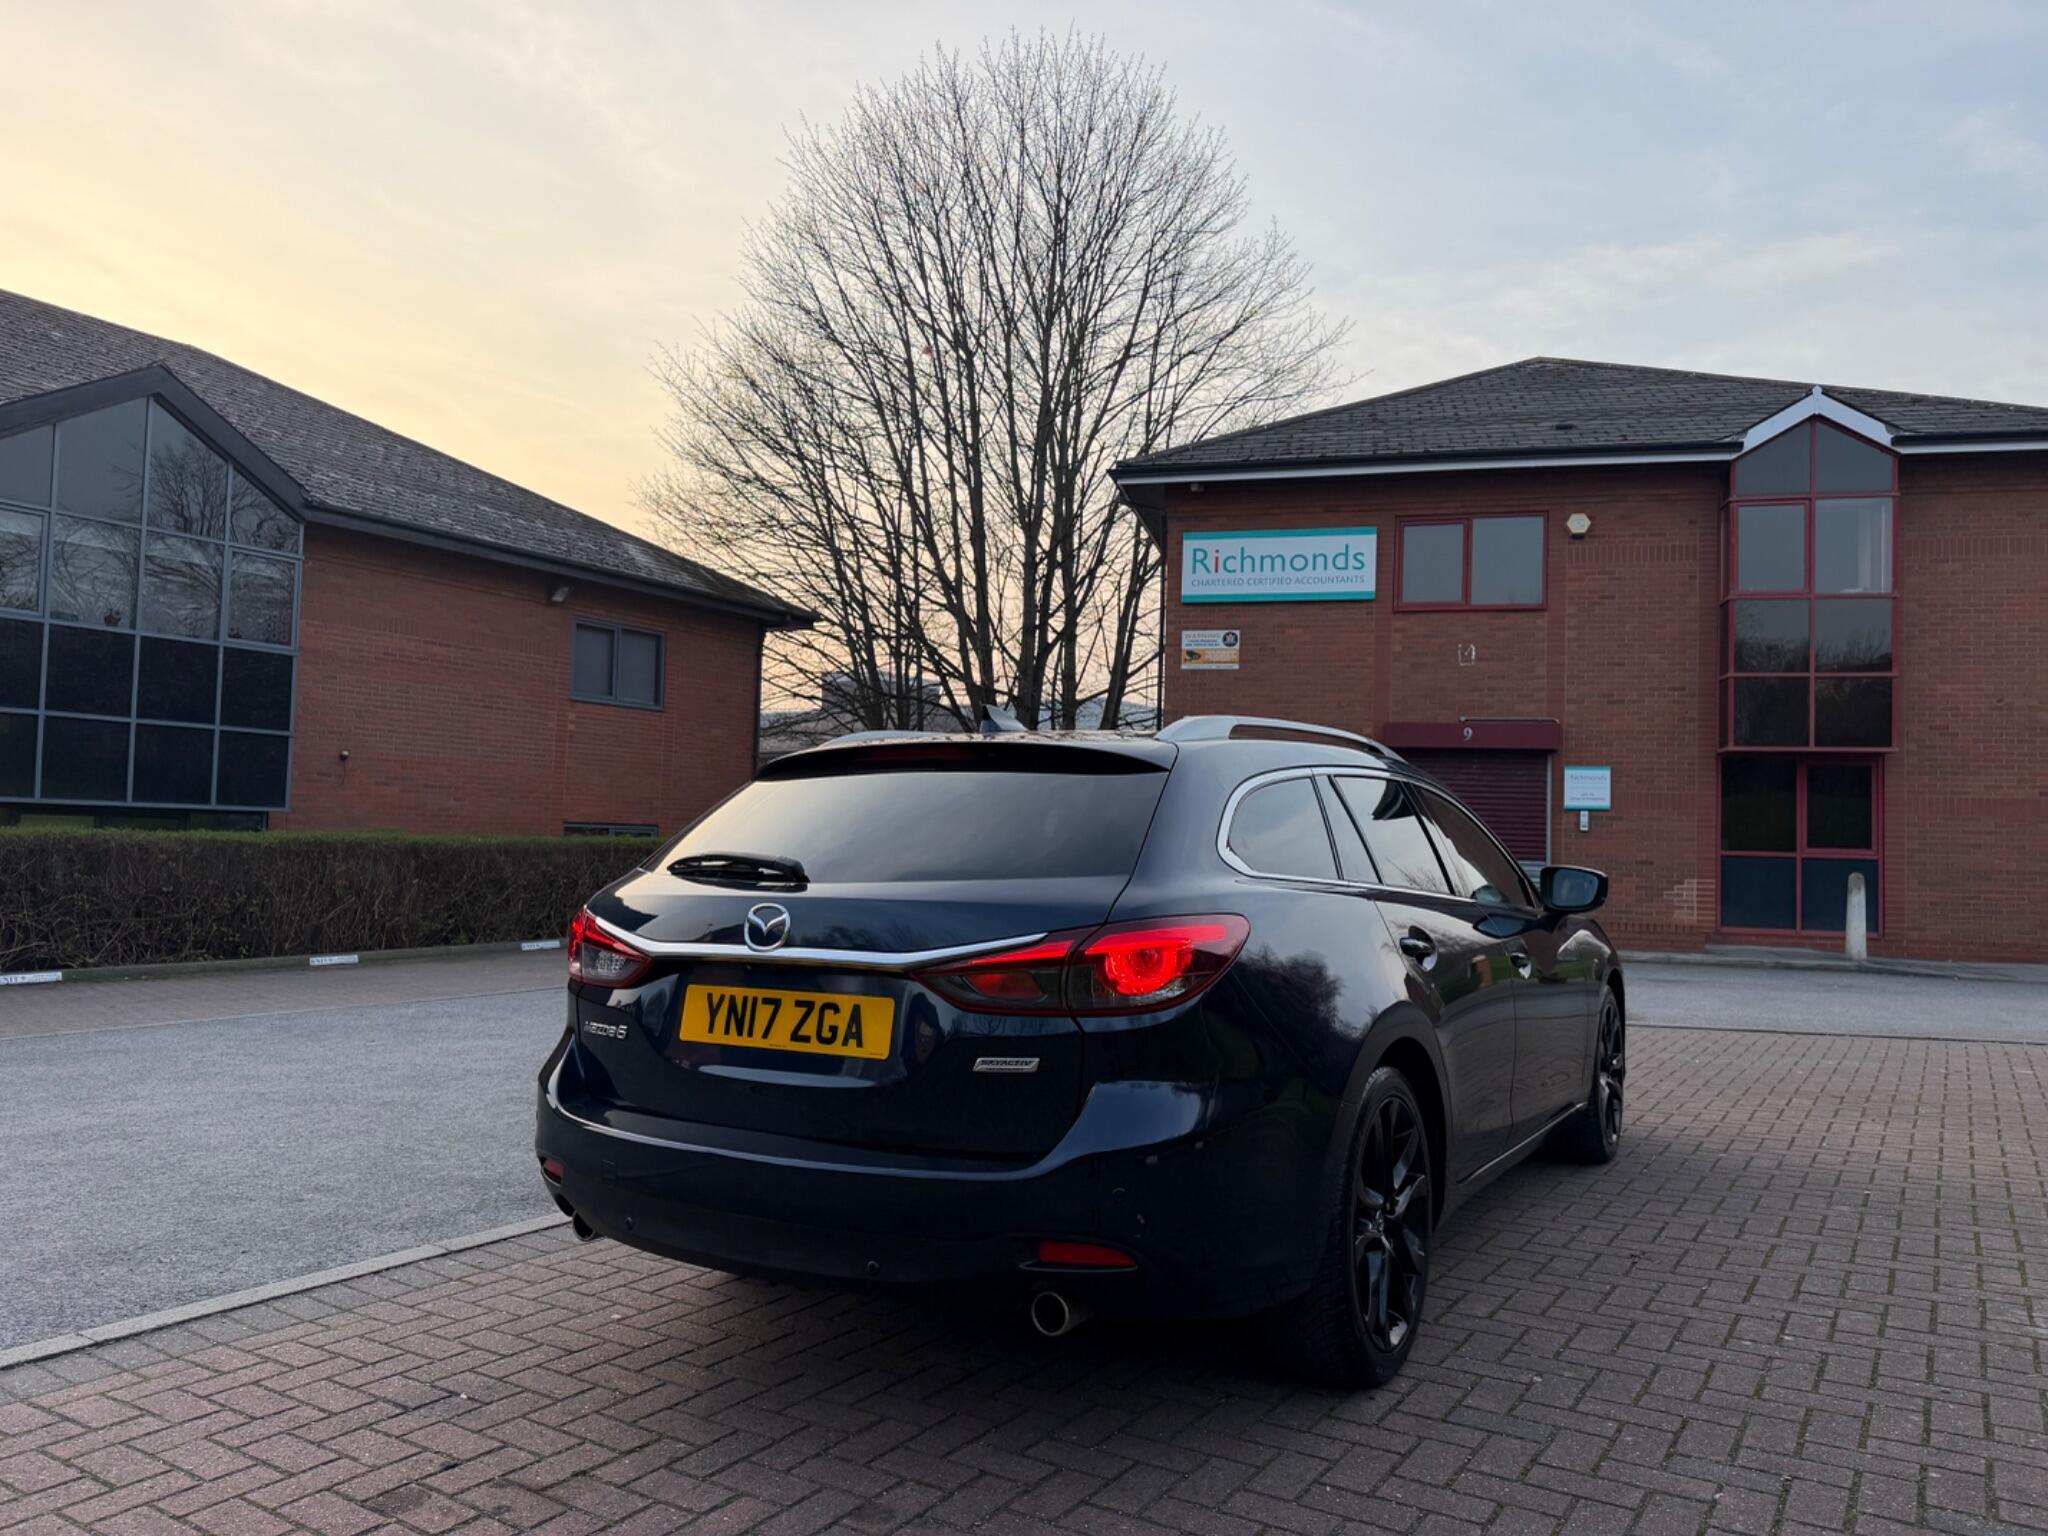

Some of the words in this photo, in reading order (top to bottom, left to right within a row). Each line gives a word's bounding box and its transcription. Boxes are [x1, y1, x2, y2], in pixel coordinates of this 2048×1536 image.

[1192, 544, 1366, 574] Richmonds
[1191, 577, 1245, 588] CHARTERED
[1247, 575, 1293, 586] CERTIFIED
[1294, 575, 1365, 585] ACCOUNTANTS
[1463, 727, 1472, 741] 9
[706, 992, 782, 1040] YN17
[790, 1000, 864, 1048] ZGA
